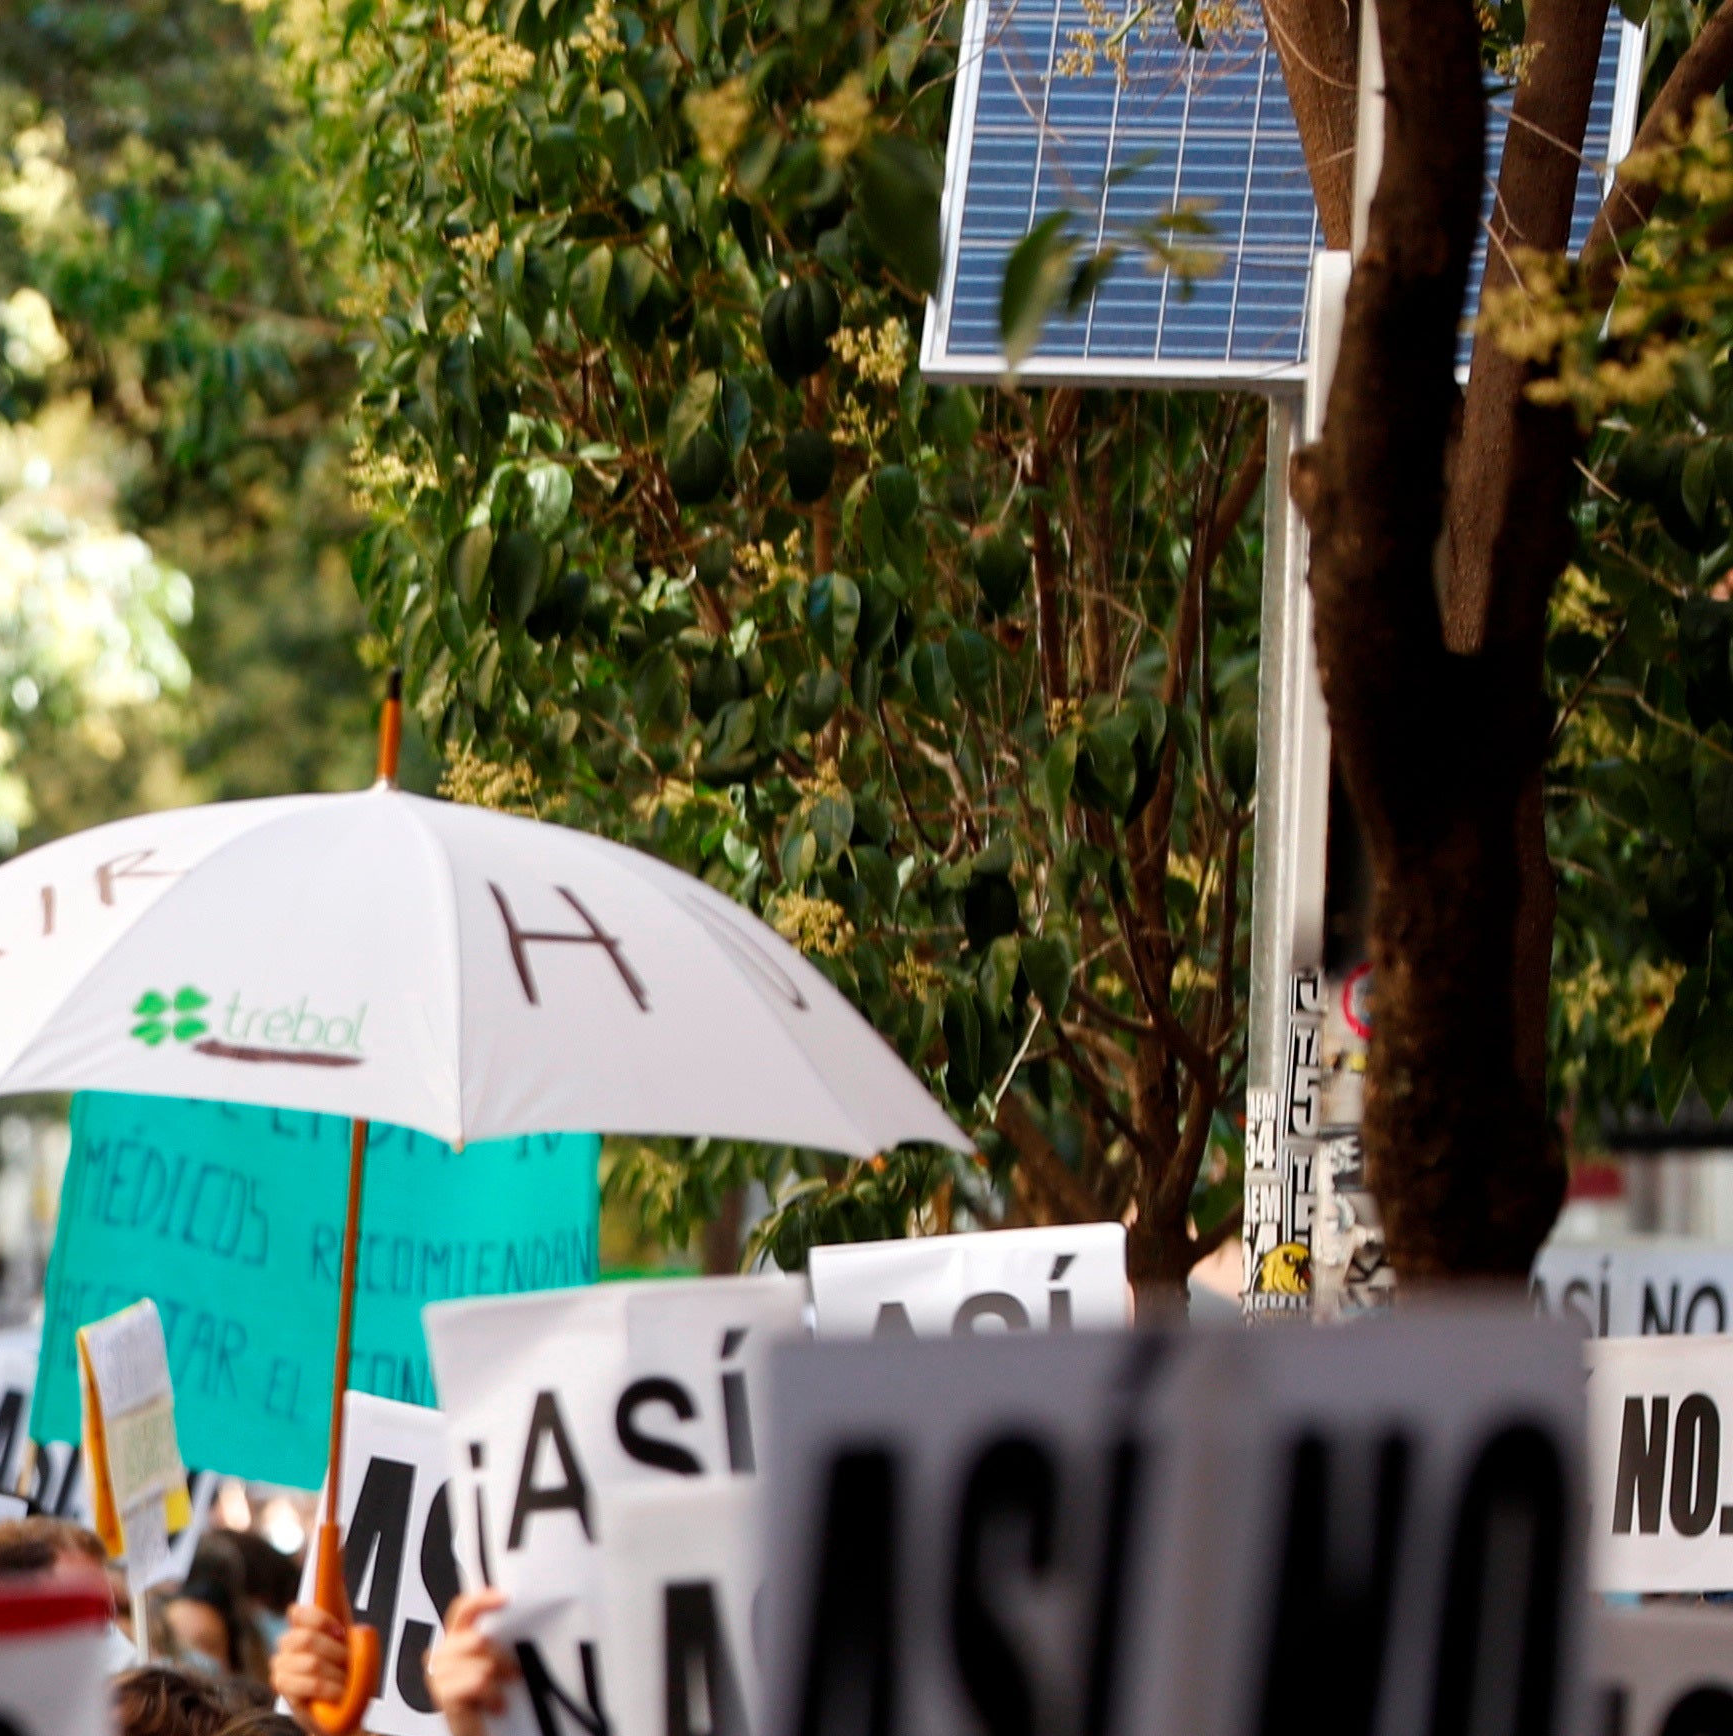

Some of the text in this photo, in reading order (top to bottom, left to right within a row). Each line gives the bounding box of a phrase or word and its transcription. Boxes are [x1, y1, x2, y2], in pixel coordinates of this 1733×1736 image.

[84, 1125, 270, 1269] MÉDICOS
[311, 1219, 595, 1296] RCOMIENDAN
[1613, 1392, 1733, 1537] NO.
